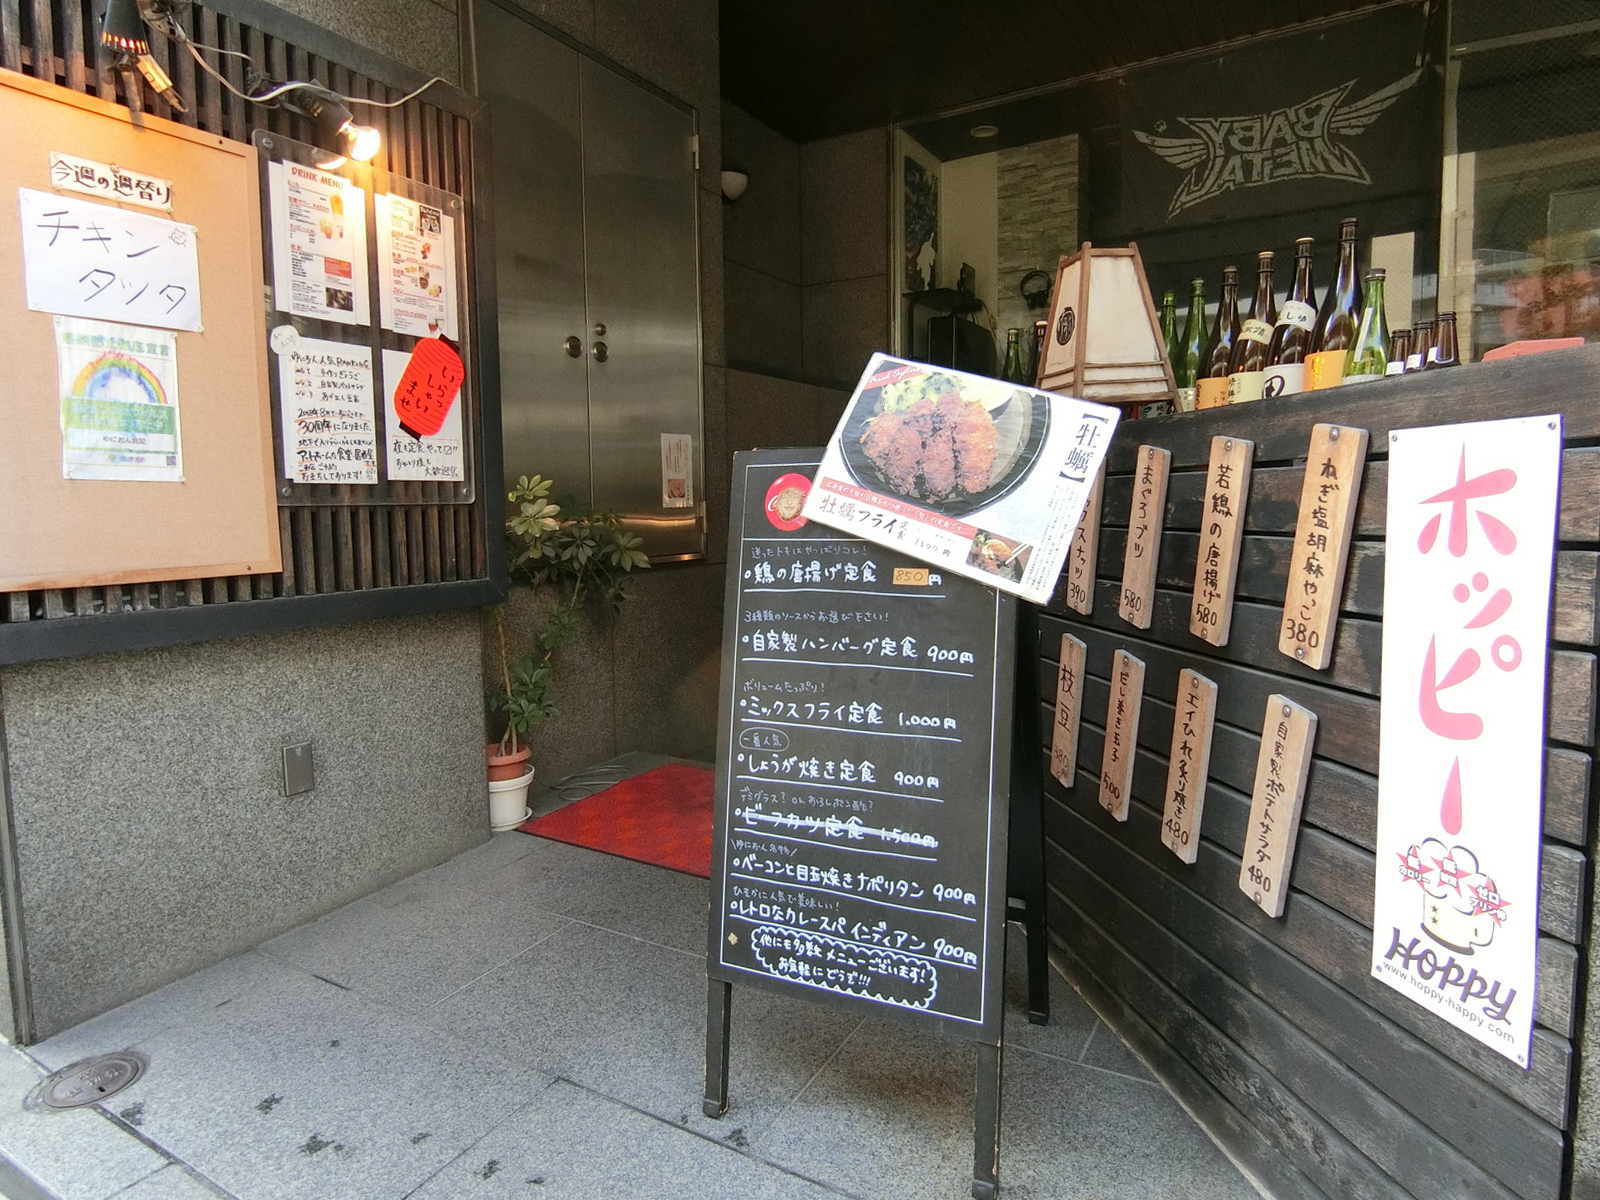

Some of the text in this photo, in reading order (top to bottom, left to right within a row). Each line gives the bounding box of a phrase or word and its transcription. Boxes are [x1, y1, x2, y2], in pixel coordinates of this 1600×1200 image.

[51, 159, 172, 205] 今週の週替り
[37, 211, 160, 258] チキン
[79, 269, 187, 315] タツタ
[1202, 463, 1234, 604] 若鶏の唐揚げ
[1302, 457, 1340, 622] ねぎ塩胡麻やっこ
[1069, 582, 1086, 603] 390
[1123, 587, 1142, 612] 580
[1195, 603, 1218, 627] 580
[1285, 618, 1320, 649] 380
[1416, 441, 1522, 836] ホッピー
[927, 645, 975, 664] 900円
[1057, 663, 1075, 733] 枝豆
[748, 752, 940, 789] しょうが焼き定食 900円
[1103, 771, 1120, 800] 500
[1164, 818, 1189, 846] 480
[1247, 865, 1272, 893] 480
[932, 884, 977, 906] 900円
[933, 937, 978, 965] 900円
[1382, 961, 1515, 1044] www.hoppy-happy.com
